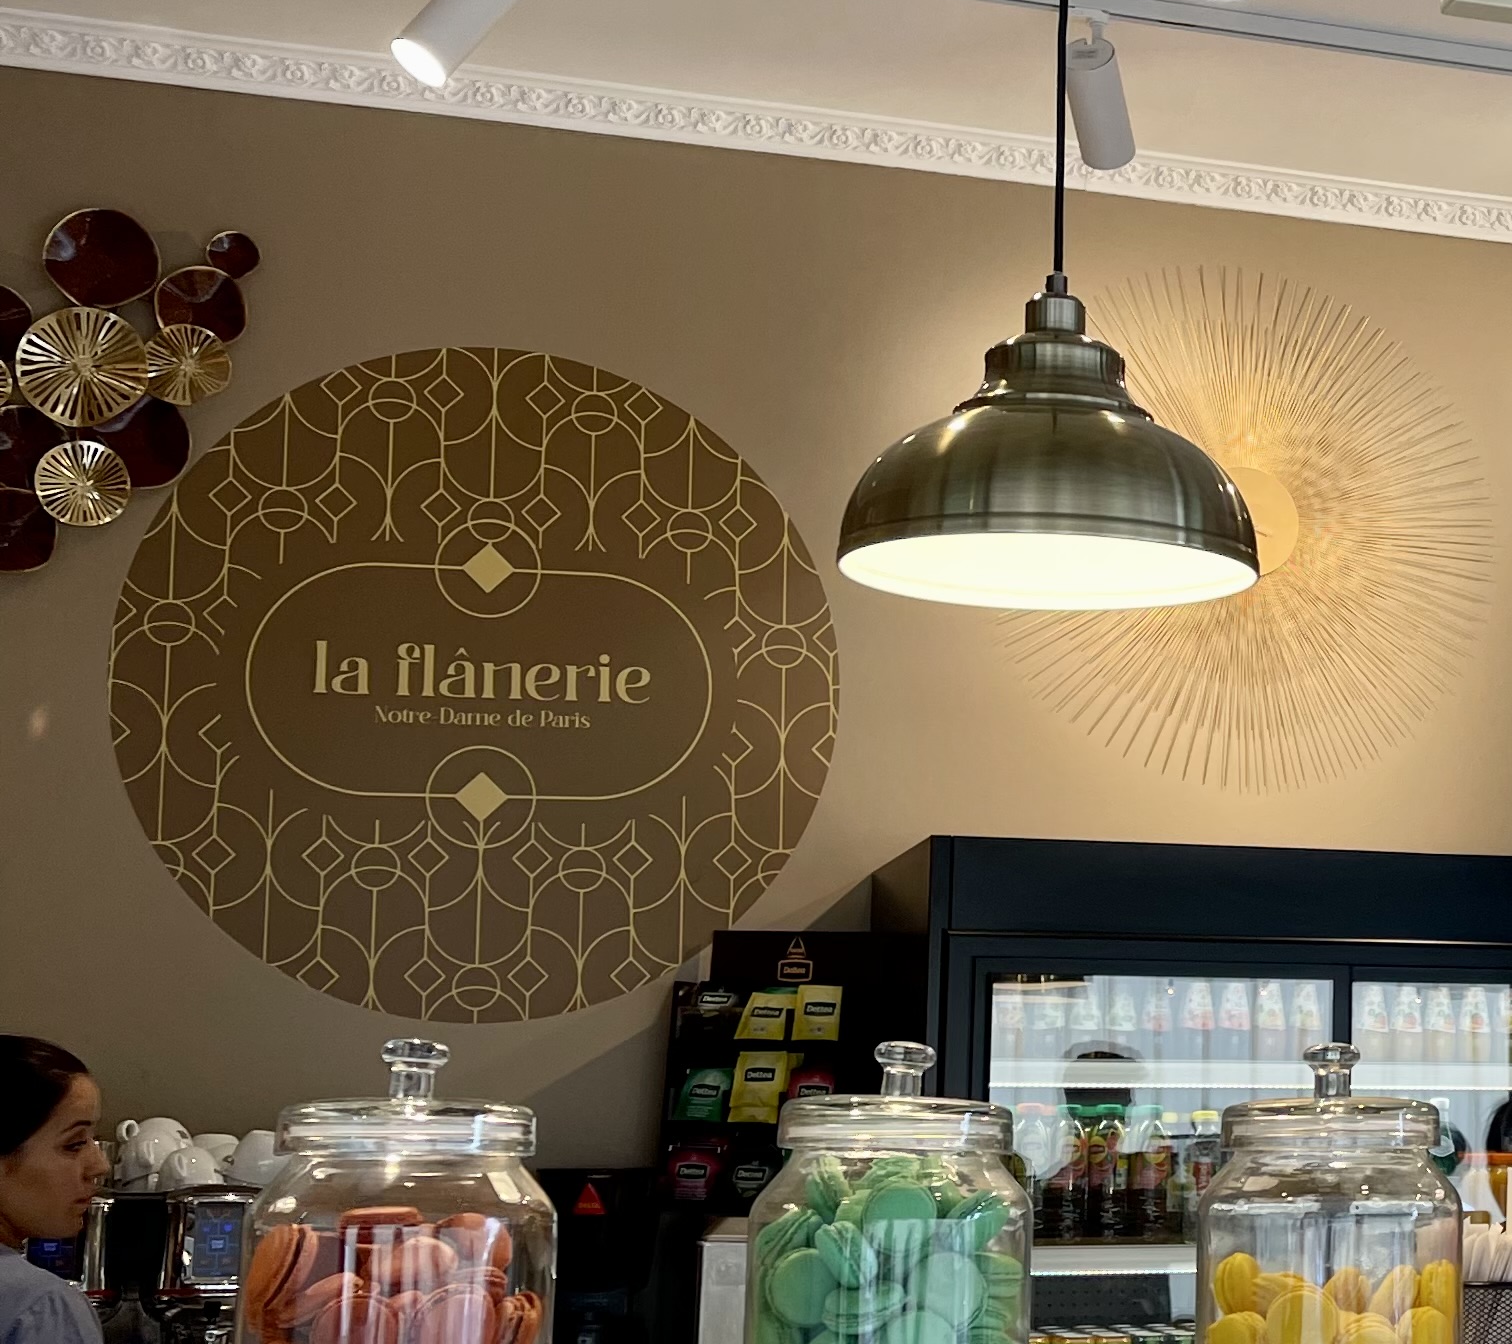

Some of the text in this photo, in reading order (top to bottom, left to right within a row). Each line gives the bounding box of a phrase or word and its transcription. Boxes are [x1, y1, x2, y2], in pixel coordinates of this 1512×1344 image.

[312, 640, 651, 705] la flânerie
[375, 706, 591, 729] Notre-Dame de Paris
